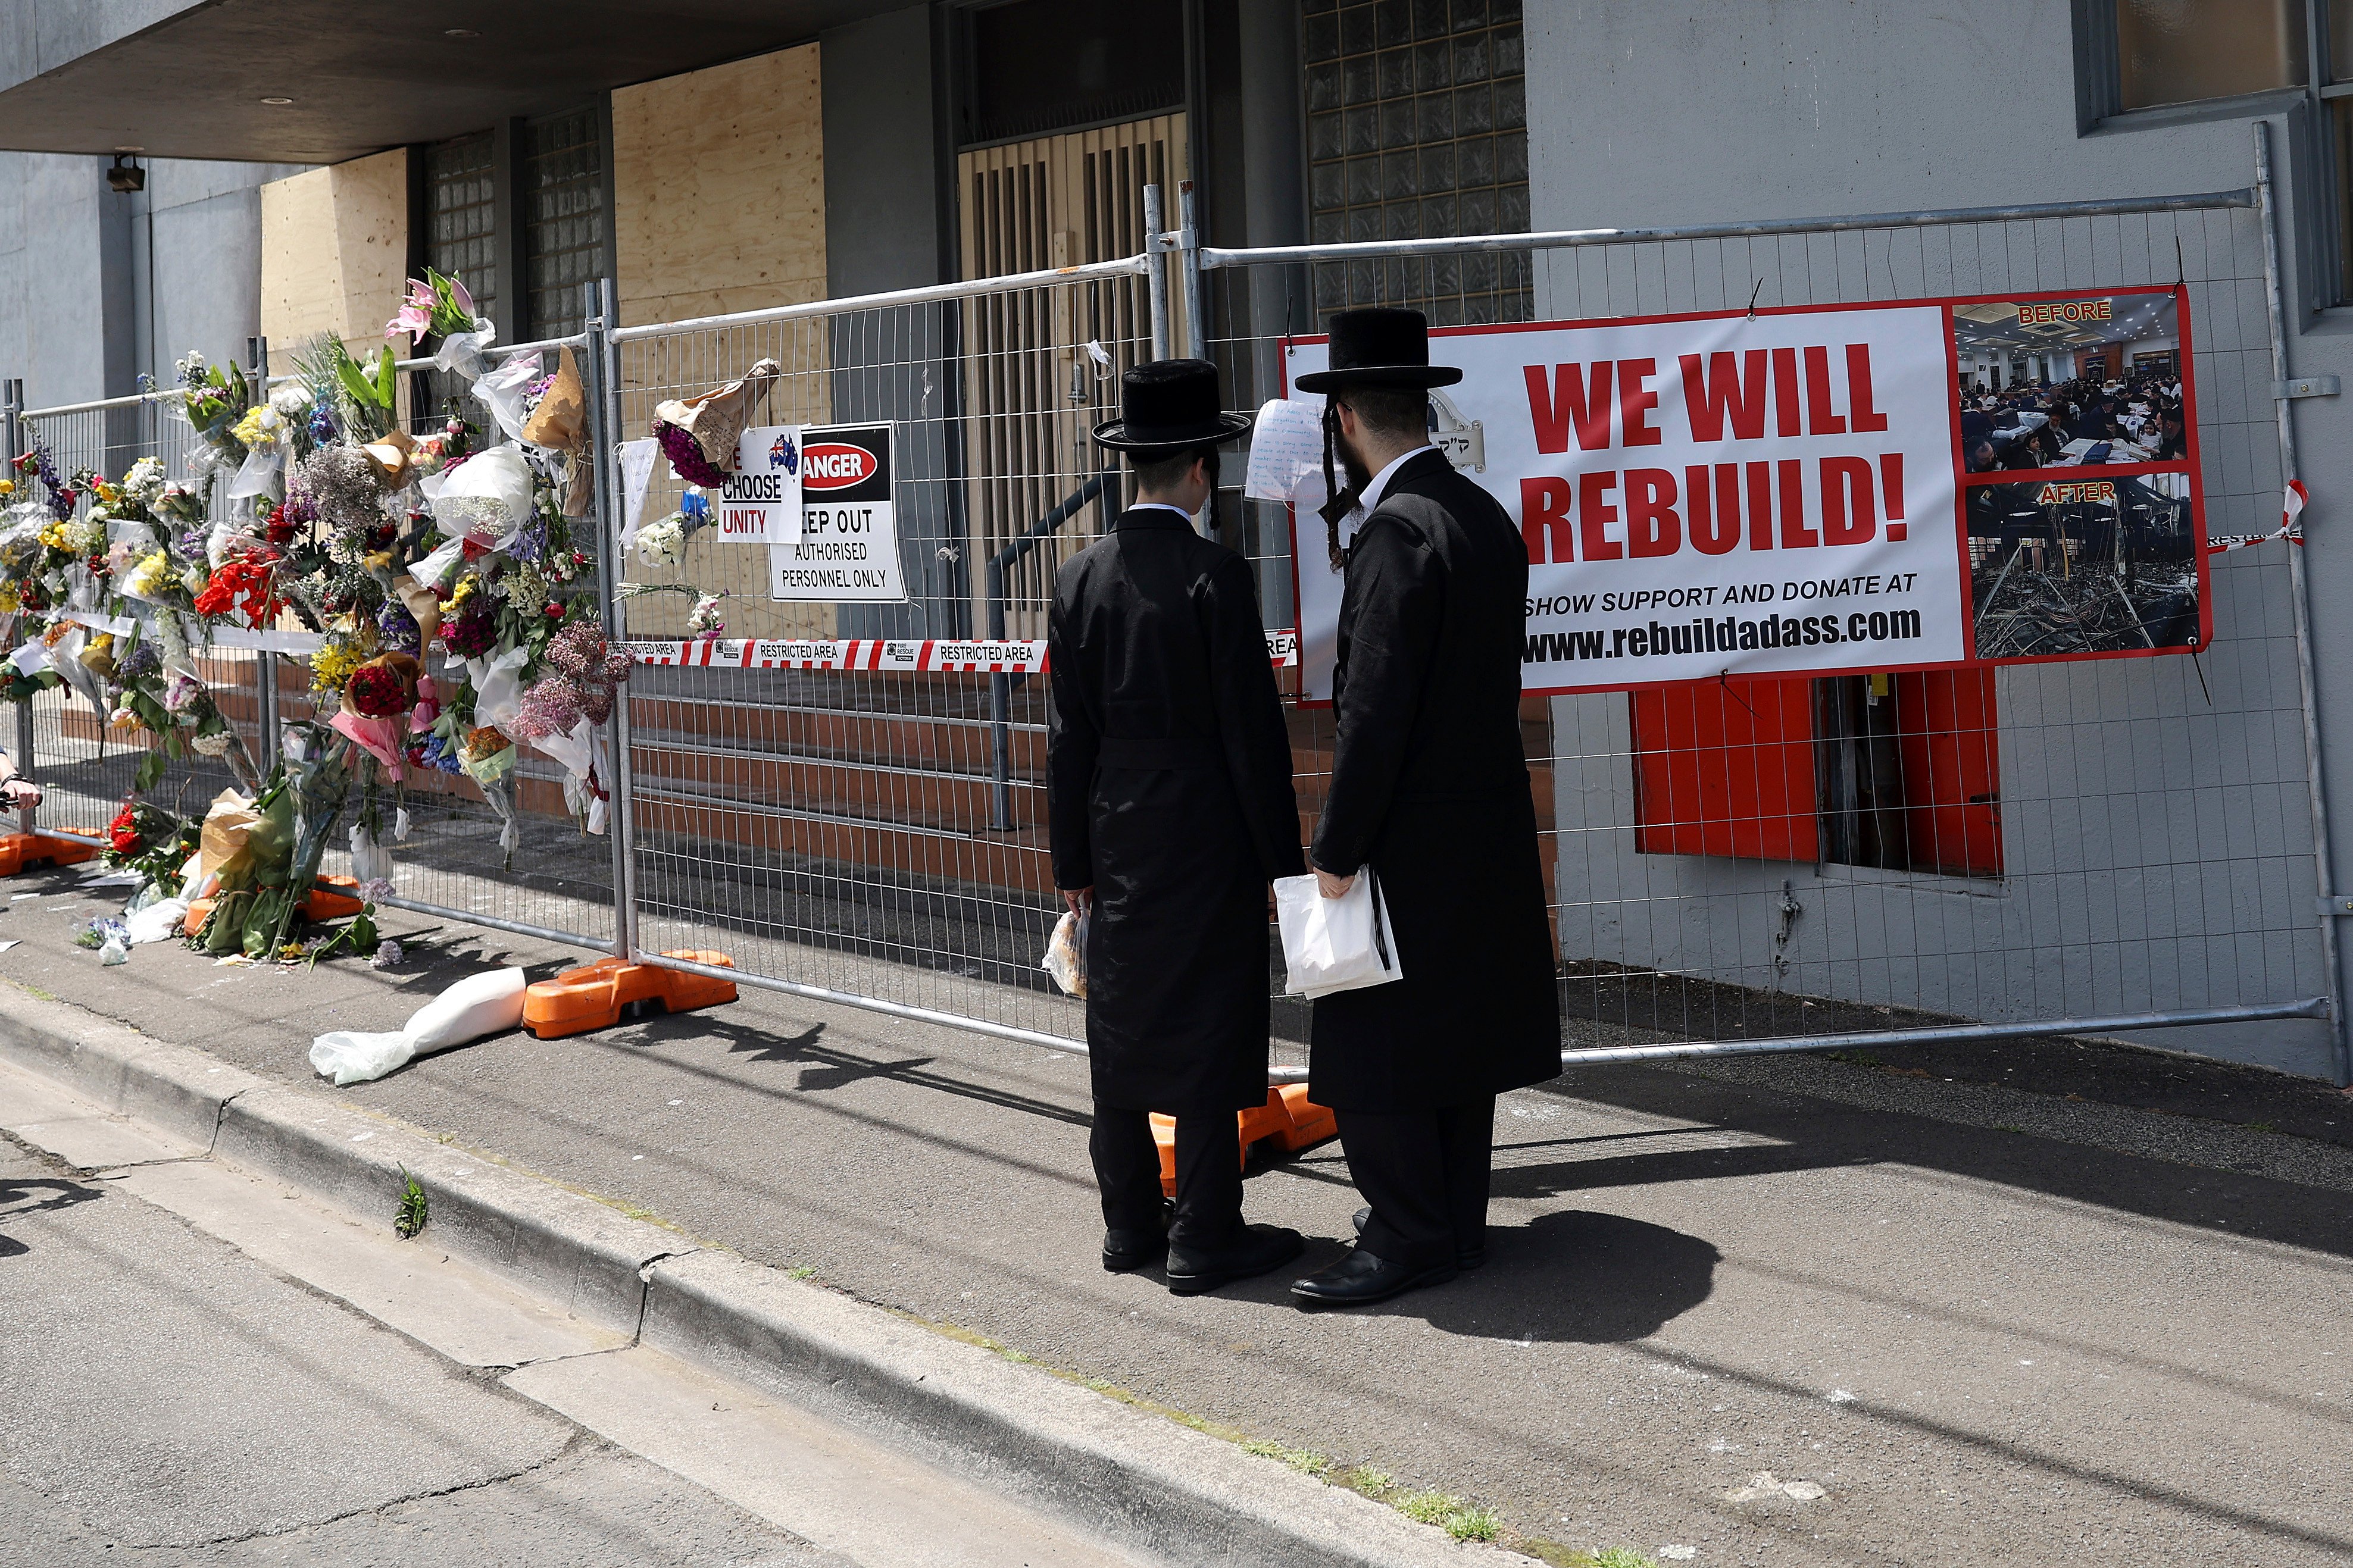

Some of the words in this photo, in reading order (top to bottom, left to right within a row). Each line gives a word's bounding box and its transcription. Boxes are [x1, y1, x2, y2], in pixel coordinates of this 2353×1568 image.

[2018, 301, 2111, 324] BEFORE
[1523, 357, 1662, 455] WE
[1678, 343, 1888, 443] WILL
[733, 447, 742, 471] E
[802, 453, 863, 479] ANGER
[723, 474, 782, 499] CHOOSE
[2040, 481, 2115, 505] AFTER
[1520, 452, 1907, 565] REBUILD!
[723, 509, 766, 534] UNITY
[802, 511, 829, 534] EP
[837, 509, 872, 534] OUT
[795, 543, 867, 561] AUTHORISED
[782, 569, 851, 588] PERSONNEL
[853, 569, 886, 587] ONLY
[1526, 594, 1596, 617] SHOW
[1601, 586, 1718, 612] SUPPORT
[1721, 583, 1775, 605] AND
[1782, 575, 1881, 601] DONATE
[1886, 572, 1918, 593] AT
[1267, 637, 1296, 655] REA
[1523, 609, 1921, 663] www.rebuildadass.com
[656, 643, 676, 655] AREA
[760, 644, 812, 658] RESTRICTED
[814, 645, 838, 659] AREA
[940, 646, 1001, 661] RESTRICTED
[1005, 646, 1034, 661] AREA
